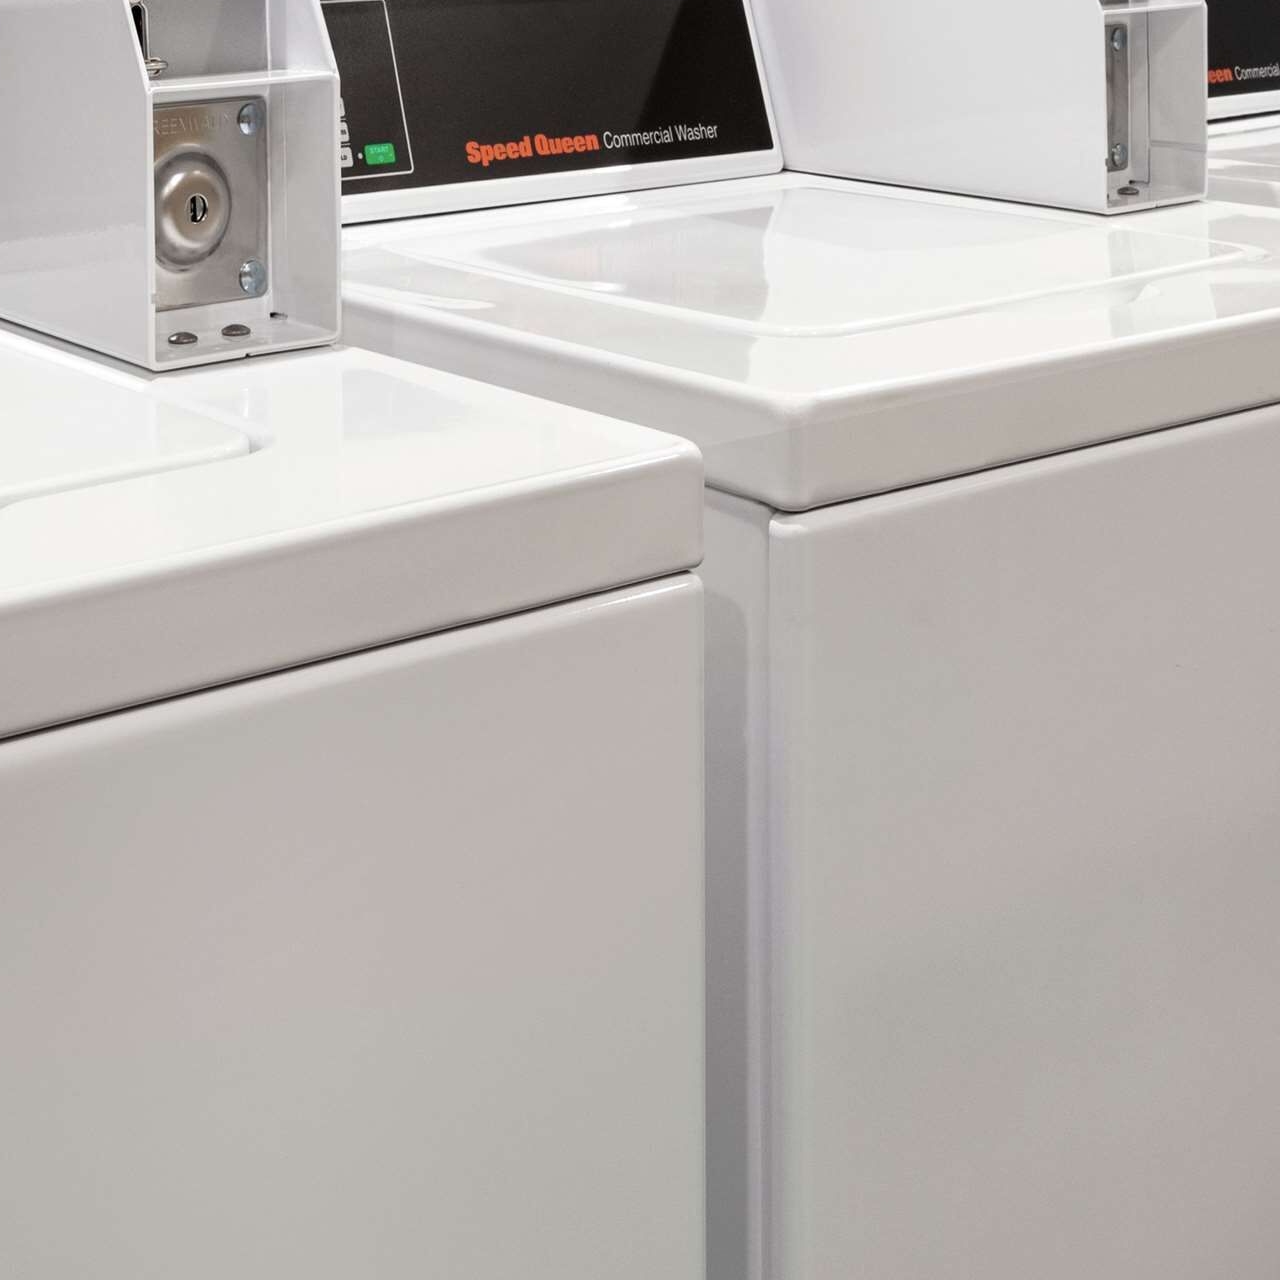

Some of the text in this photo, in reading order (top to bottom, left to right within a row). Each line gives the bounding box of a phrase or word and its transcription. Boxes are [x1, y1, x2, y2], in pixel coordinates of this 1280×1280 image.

[1207, 67, 1233, 84] een
[1234, 63, 1280, 80] Commercial
[465, 123, 718, 166] Speed Queen Commercial Washer
